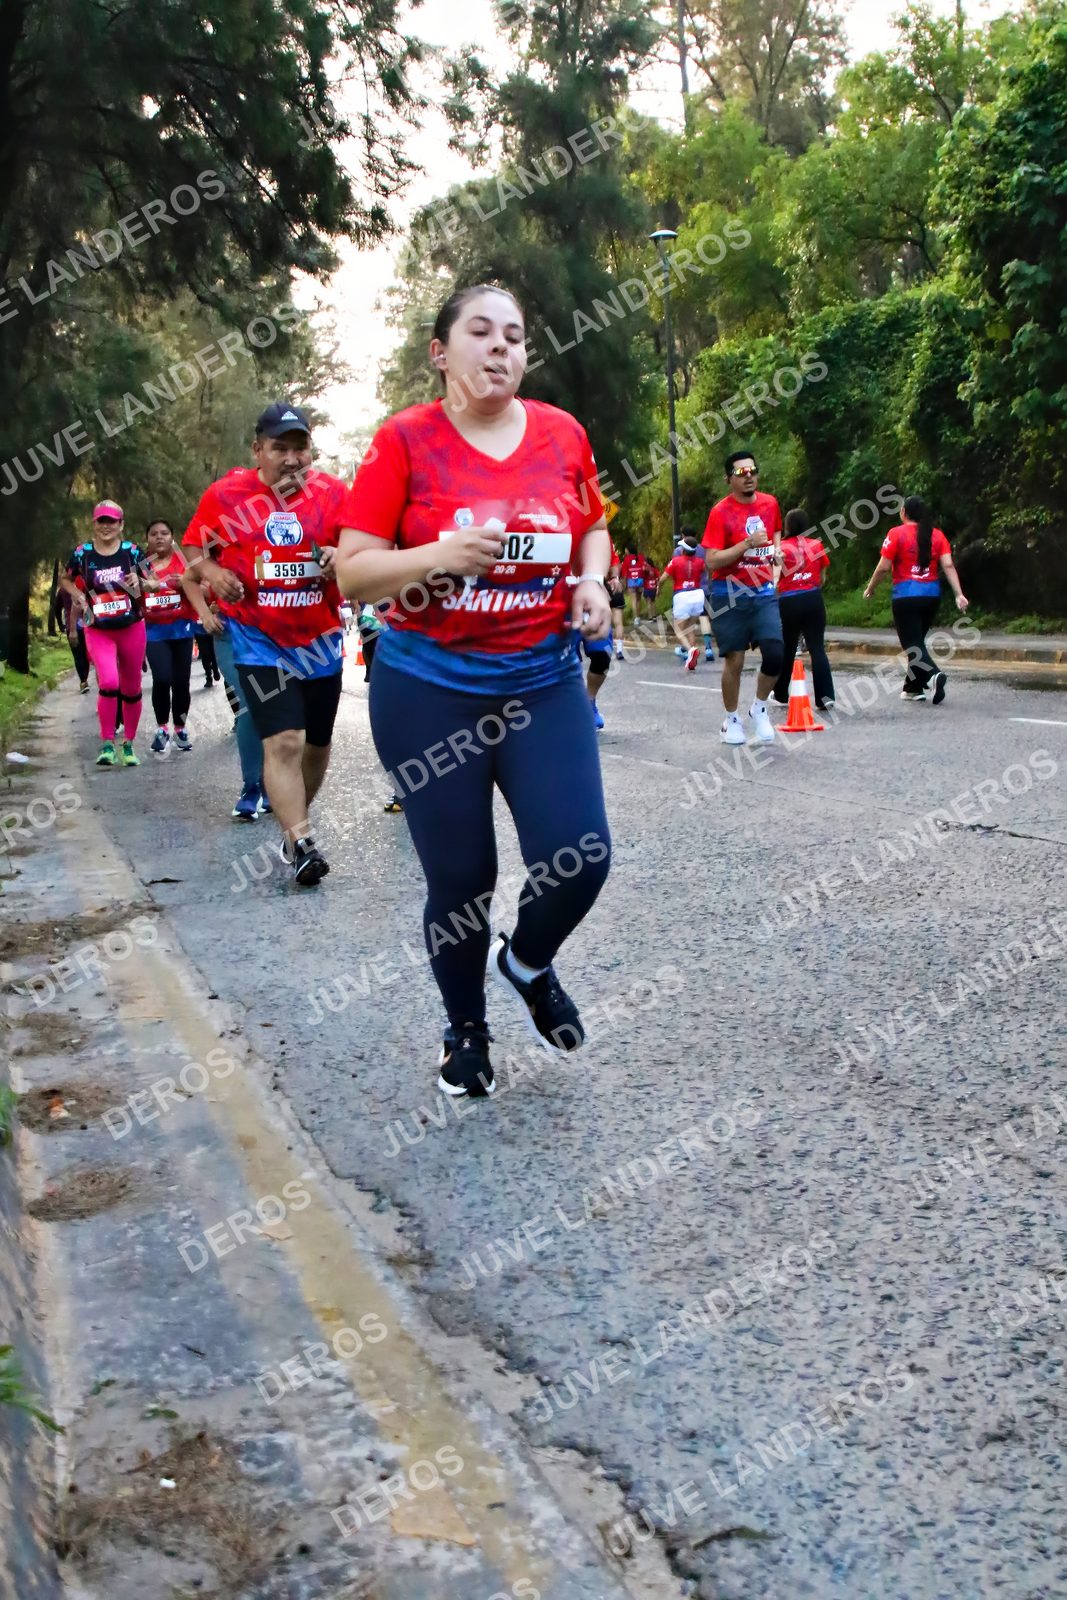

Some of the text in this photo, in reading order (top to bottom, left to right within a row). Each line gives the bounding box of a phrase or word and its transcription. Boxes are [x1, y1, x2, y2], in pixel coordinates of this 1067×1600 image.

[96, 566, 122, 577] POWER
[274, 563, 305, 577] 3593
[257, 591, 323, 607] SANTIAGO
